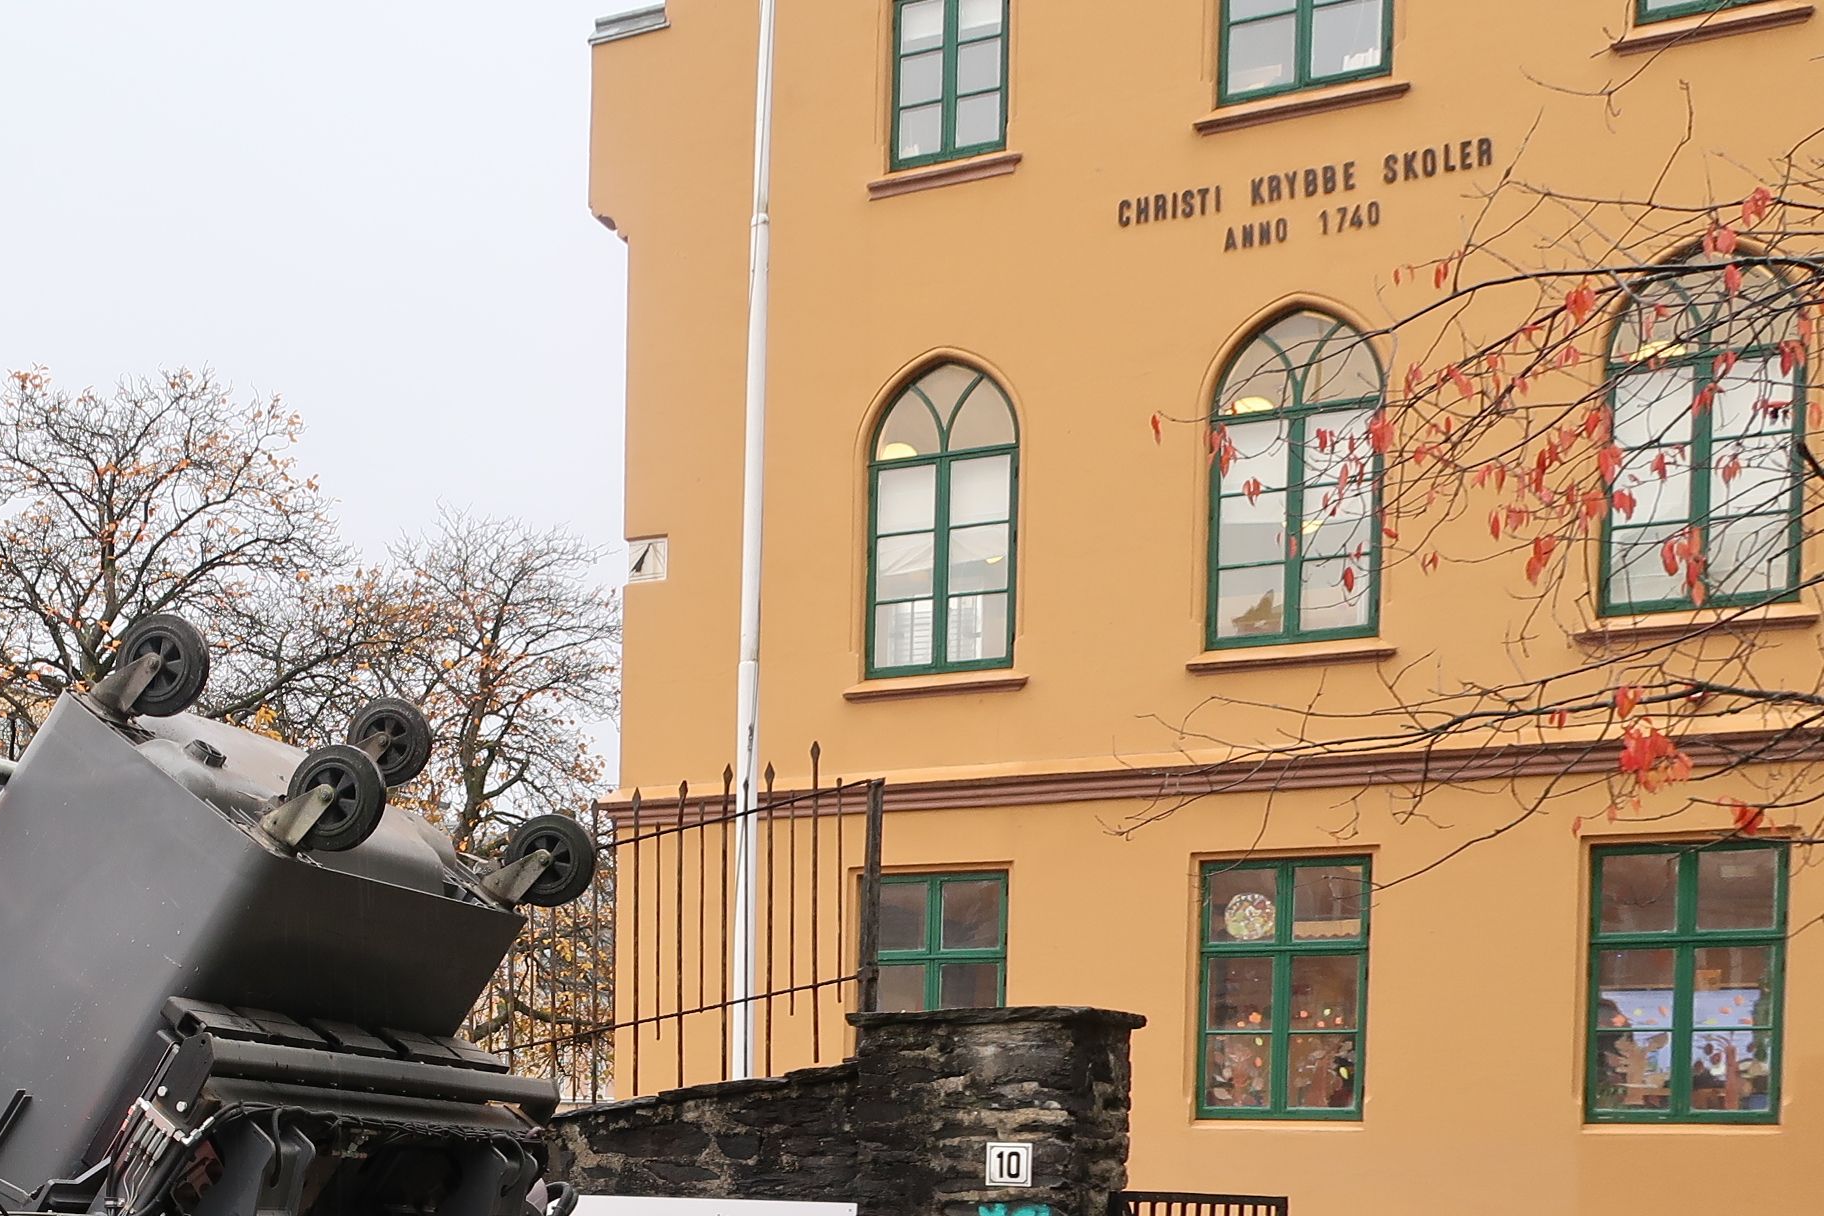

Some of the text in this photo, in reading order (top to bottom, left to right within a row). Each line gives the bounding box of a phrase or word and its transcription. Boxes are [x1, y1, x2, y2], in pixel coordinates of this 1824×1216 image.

[1117, 137, 1494, 228] CHRISTI KRYBBE SKOLER
[1223, 200, 1382, 254] ANNO 1740
[995, 1150, 1021, 1179] 10
